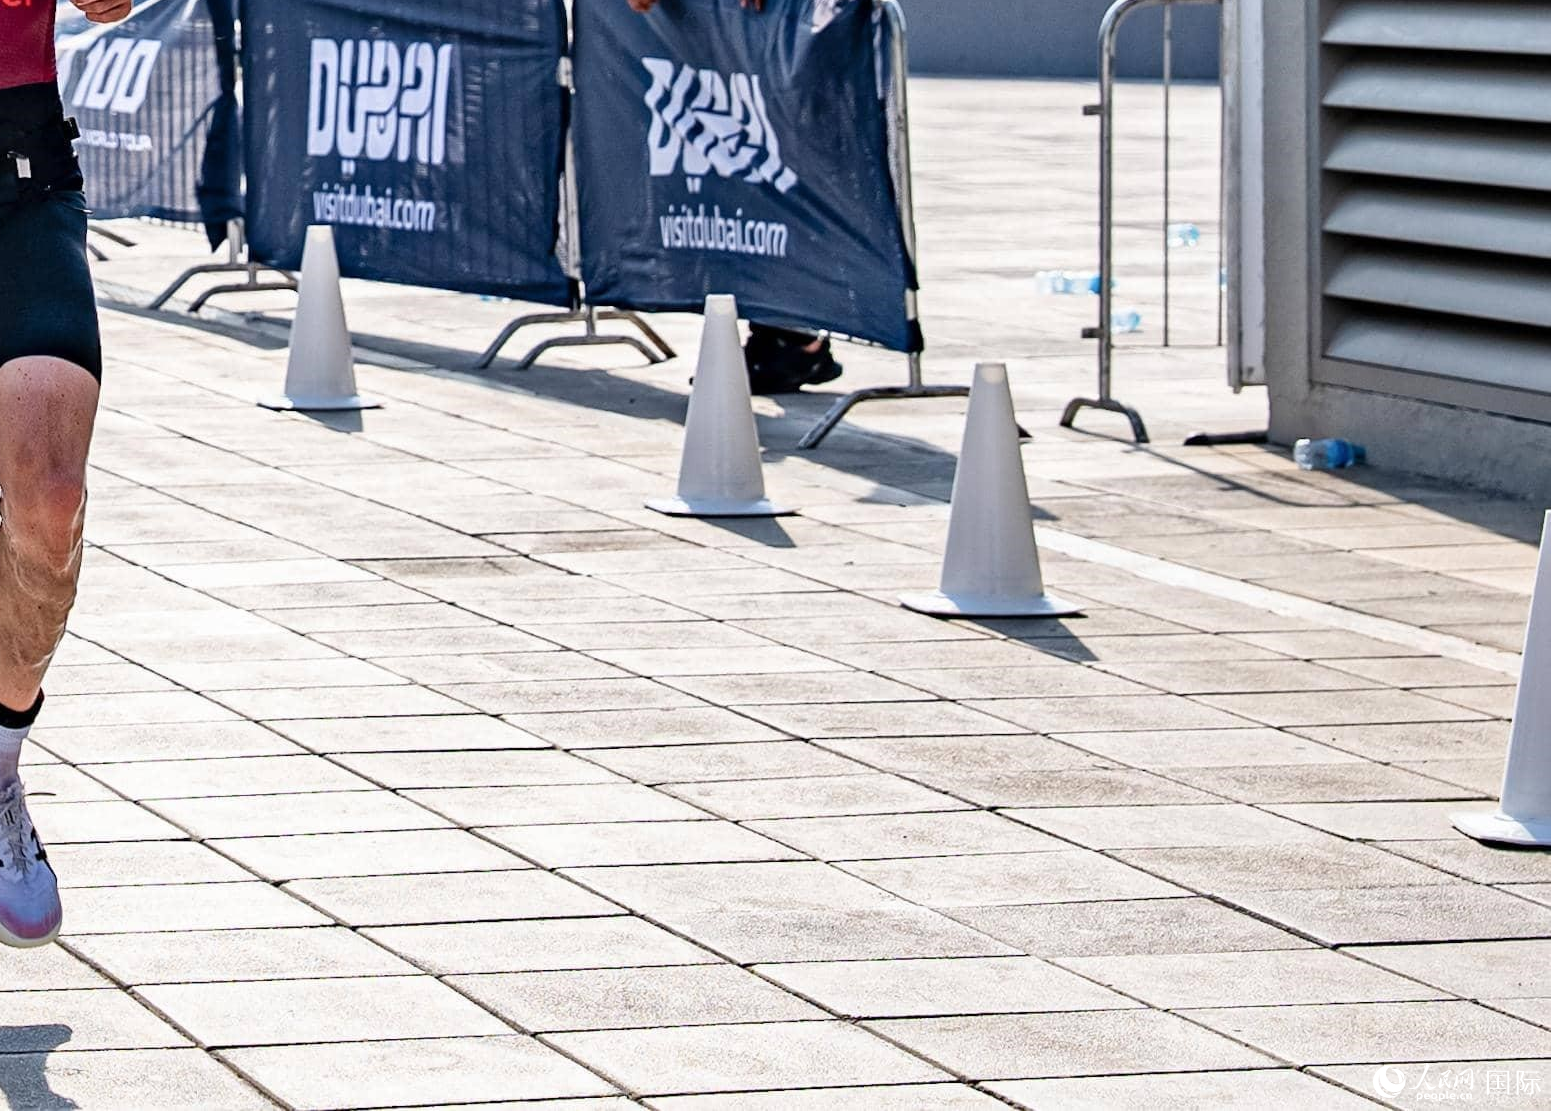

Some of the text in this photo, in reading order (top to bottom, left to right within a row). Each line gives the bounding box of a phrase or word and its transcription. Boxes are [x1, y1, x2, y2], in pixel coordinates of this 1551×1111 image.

[307, 38, 453, 166] DUBAI
[313, 182, 436, 232] visitdubai.com
[659, 204, 788, 258] visitdubai.com
